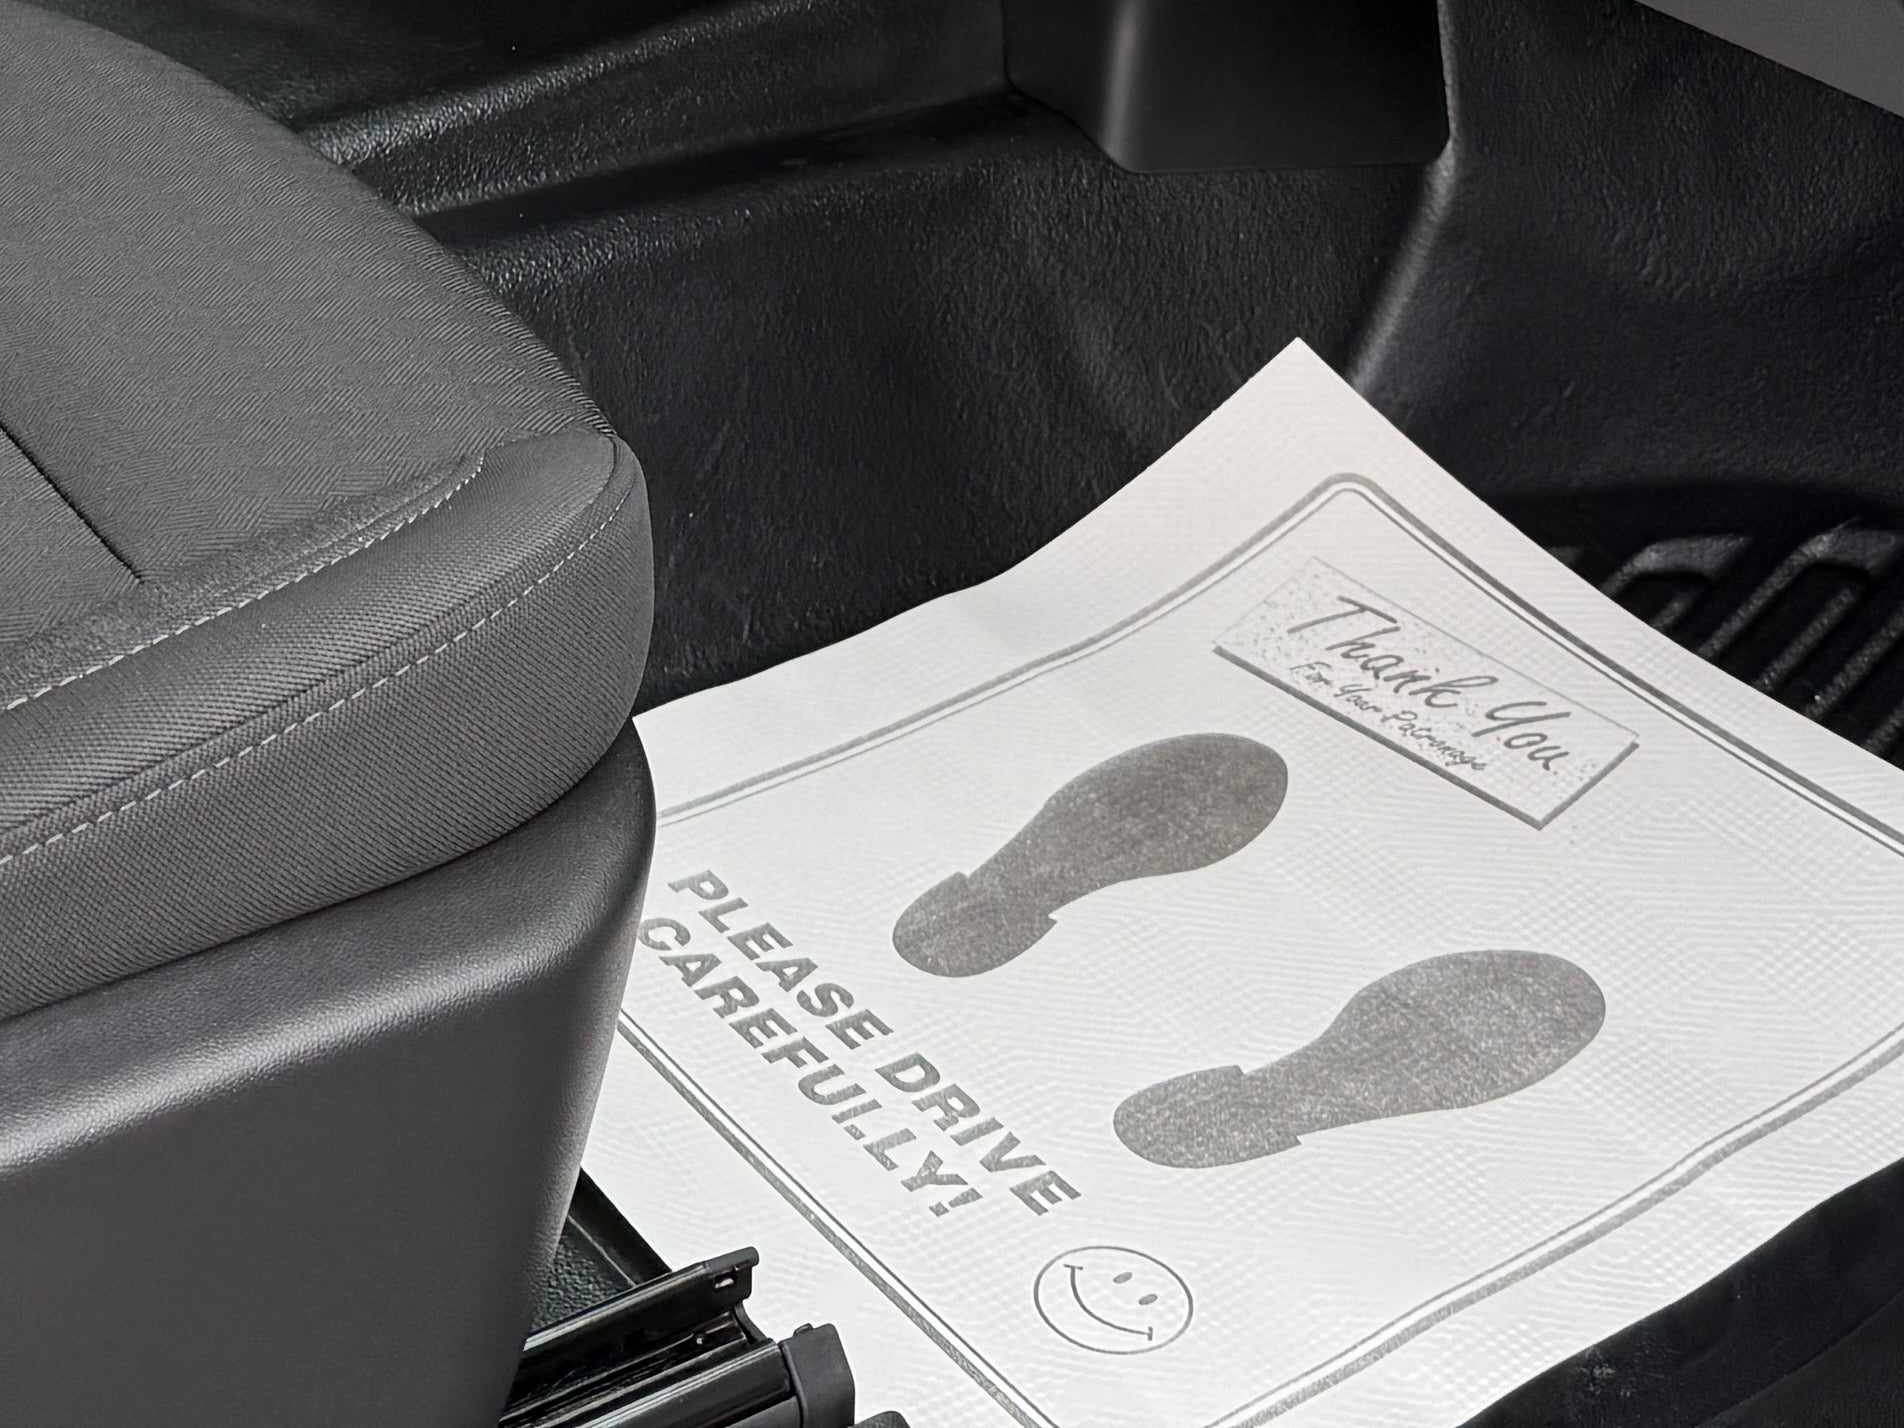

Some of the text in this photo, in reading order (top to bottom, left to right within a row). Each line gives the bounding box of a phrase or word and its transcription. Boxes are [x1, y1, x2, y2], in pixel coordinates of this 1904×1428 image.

[1287, 596, 1571, 771] Thank You
[637, 917, 984, 1218] CAREFULLY!
[667, 869, 1082, 1217] PLEASE DRIVE
